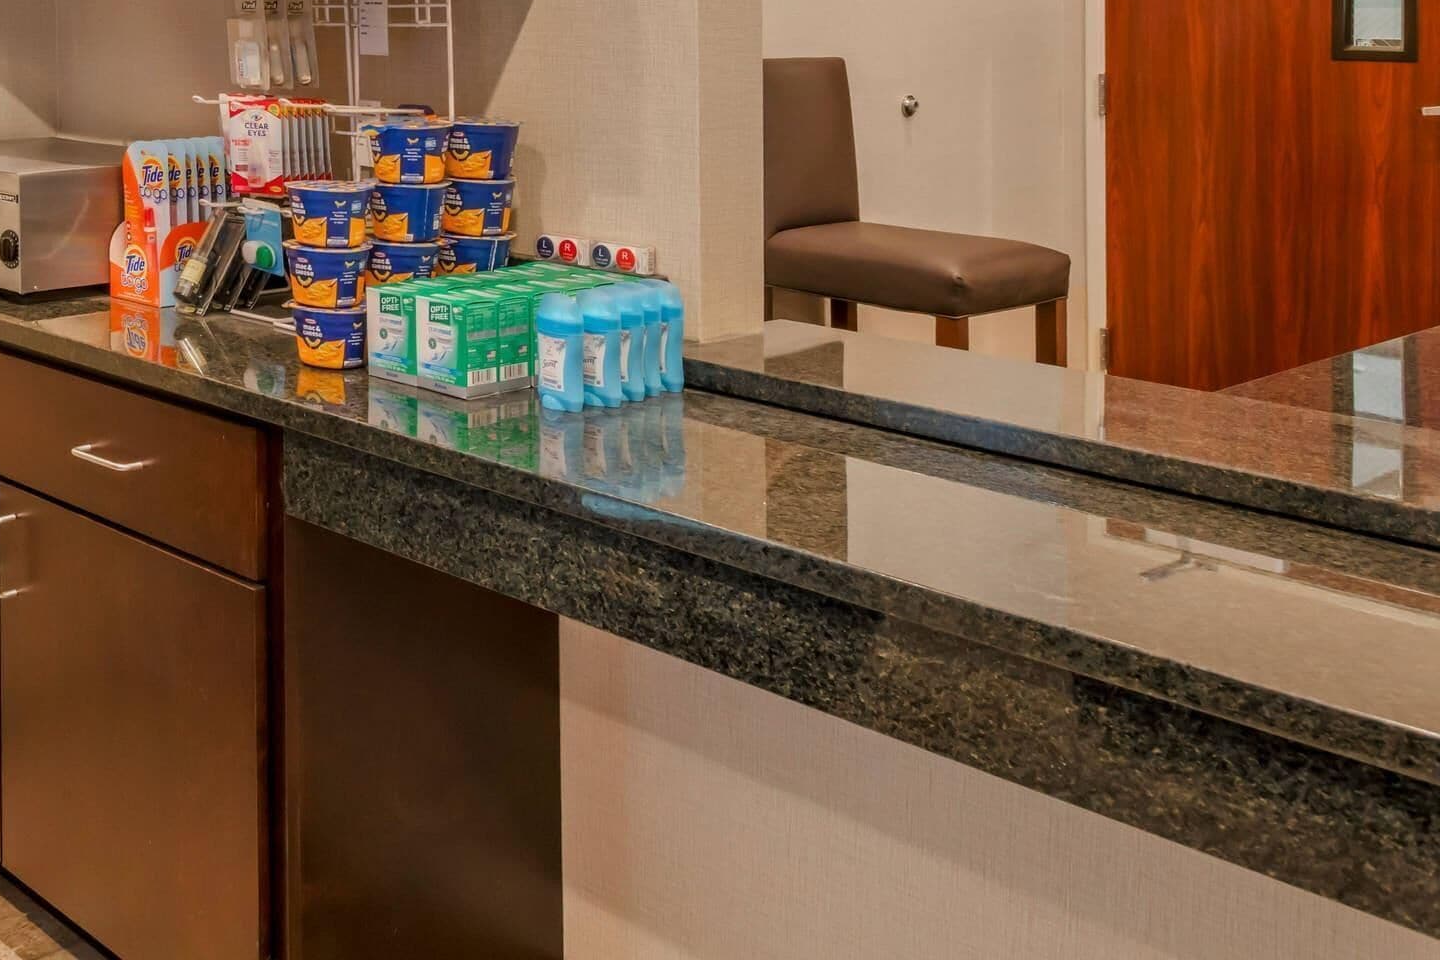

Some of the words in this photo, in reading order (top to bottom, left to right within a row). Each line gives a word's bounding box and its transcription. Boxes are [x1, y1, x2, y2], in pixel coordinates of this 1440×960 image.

[244, 122, 269, 130] CLEAR
[142, 165, 163, 186] Tide
[153, 188, 168, 204] go
[542, 240, 548, 249] L
[564, 243, 571, 252] R
[178, 245, 192, 262] Tid
[598, 248, 604, 257] L
[621, 252, 629, 260] R
[126, 255, 145, 274] Tide
[381, 296, 399, 305] OPTI-
[381, 303, 400, 311] FREE
[430, 305, 449, 314] OPTI-
[430, 312, 449, 321] FREE
